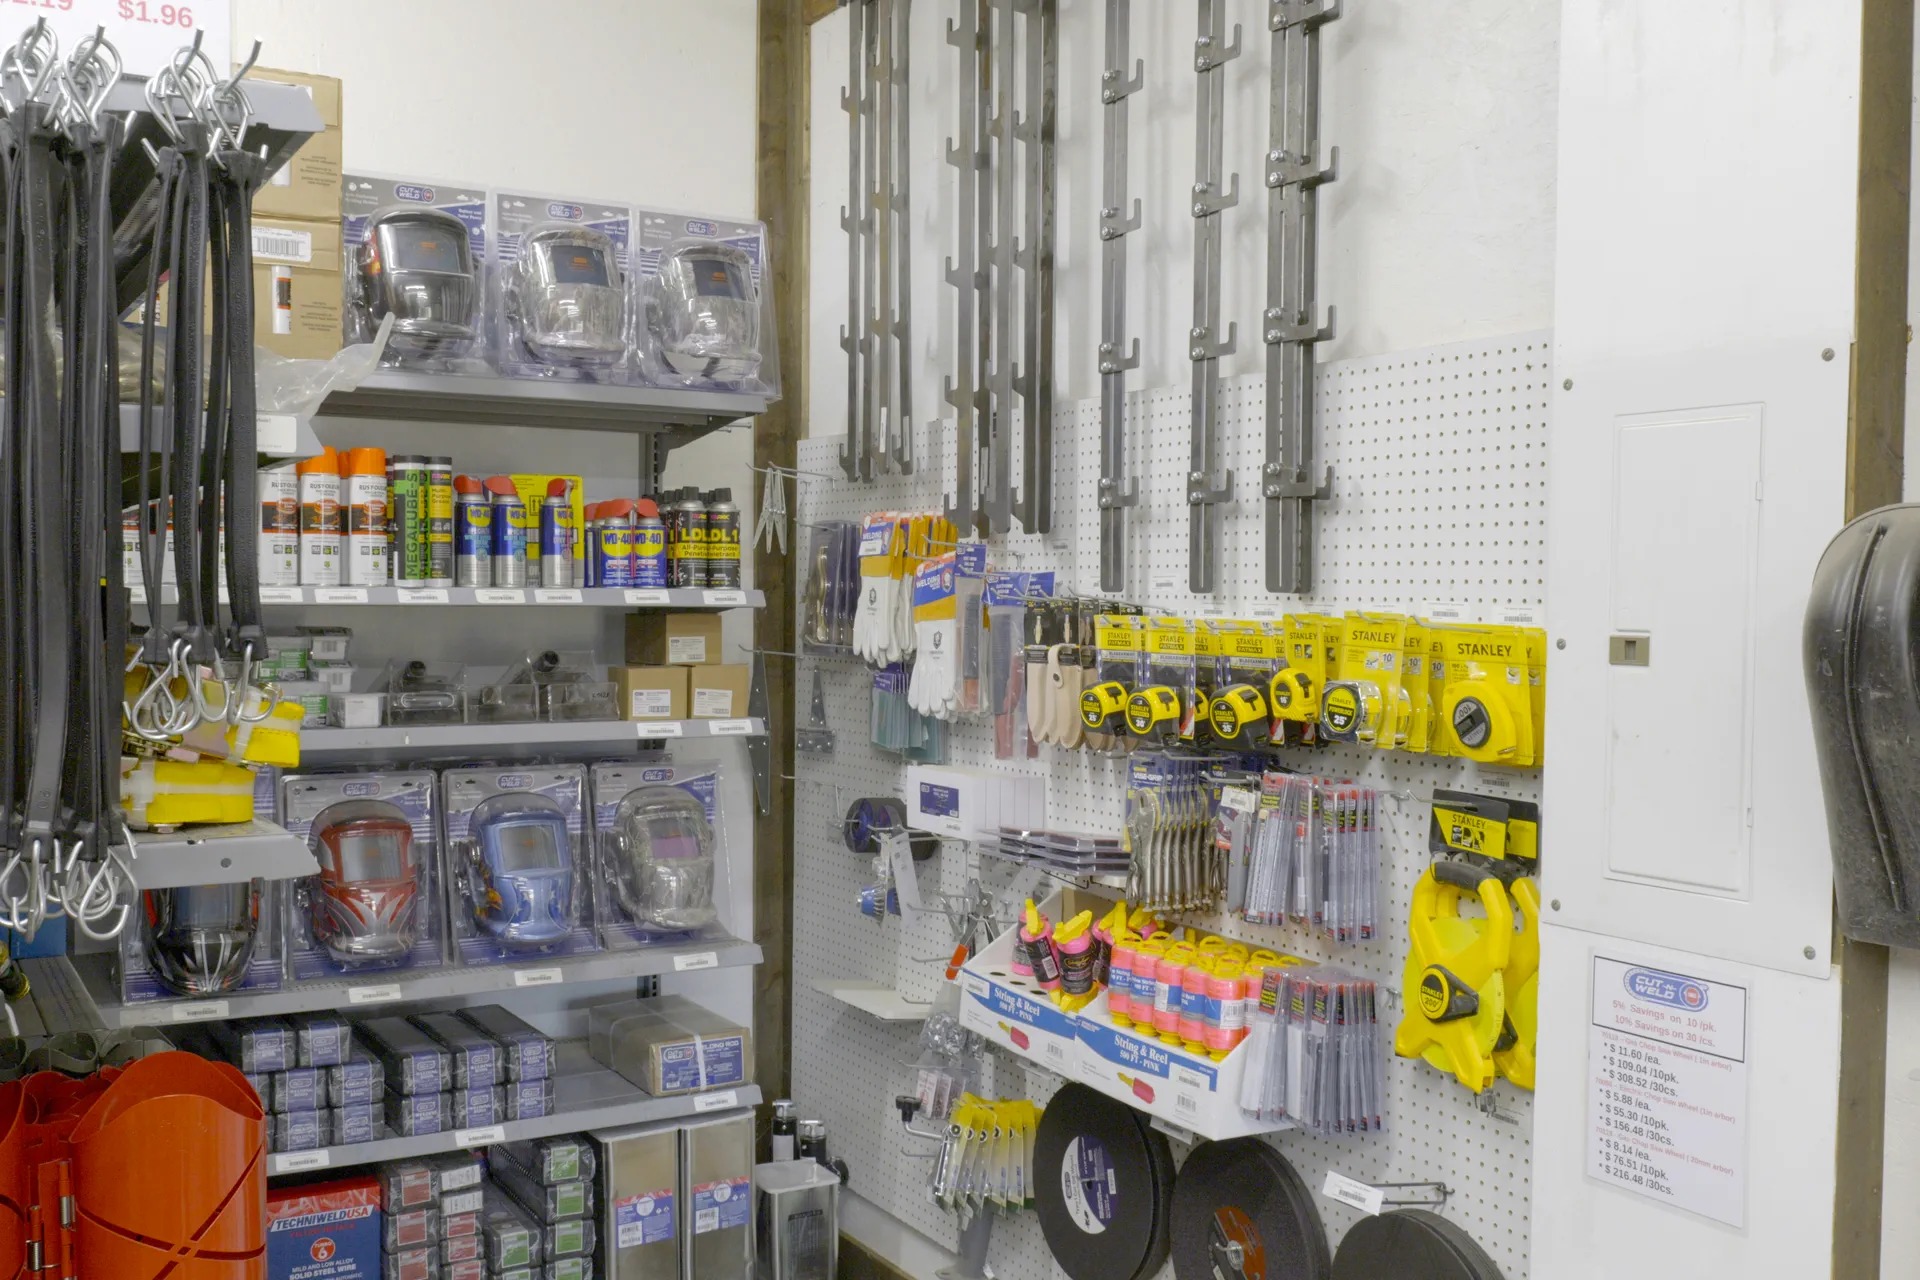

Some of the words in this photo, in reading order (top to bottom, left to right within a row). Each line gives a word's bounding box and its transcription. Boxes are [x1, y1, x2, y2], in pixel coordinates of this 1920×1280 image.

[118, 0, 193, 28] $1.96
[407, 472, 418, 577] MEGALUBE-S
[1108, 632, 1131, 640] STANLEY
[1236, 638, 1262, 646] STANLEY
[1290, 632, 1318, 640] STANLEY
[1352, 630, 1396, 643] STANLEY
[1458, 643, 1512, 656] STANLEY
[1332, 697, 1352, 706] STANLEY
[1134, 772, 1162, 780] VISE-GRIP
[1452, 814, 1486, 830] STANLEY
[1636, 976, 1664, 987] CUT
[1420, 986, 1444, 1000] STANLEY
[1635, 983, 1675, 1000] WELD
[994, 987, 1016, 1008] String
[1016, 998, 1022, 1008] &
[1024, 1000, 1040, 1017] Reel
[1008, 1006, 1016, 1015] FT
[1019, 1010, 1034, 1023] PINK
[1613, 1000, 1626, 1010] 5%
[1630, 1004, 1665, 1020] Savings
[1670, 1014, 1682, 1024] on
[1687, 1018, 1698, 1028] 10
[1615, 1015, 1634, 1027] 10%
[1634, 1020, 1670, 1036] Savings
[1672, 1030, 1684, 1040] on
[1686, 1032, 1698, 1043] 30
[1114, 1034, 1139, 1056] String
[1140, 1045, 1148, 1057] &
[1149, 1048, 1168, 1066] Reel
[1618, 1046, 1642, 1060] 11.60
[1644, 1052, 1661, 1065] /ea.
[1639, 1041, 1656, 1052] Chop
[1672, 1050, 1693, 1060] Wheel
[1120, 1050, 1130, 1061] 500
[1130, 1053, 1140, 1064] FT
[1143, 1059, 1160, 1073] PINK
[1617, 1060, 1648, 1075] 109.04
[1650, 1068, 1680, 1084] /10pk.
[1617, 1072, 1648, 1088] 308.52
[1650, 1082, 1678, 1098] /30cs.
[1614, 1092, 1633, 1106] 5.88
[1634, 1098, 1652, 1112] /ea.
[1644, 1092, 1662, 1103] Chop
[1662, 1097, 1676, 1106] Saw
[1678, 1102, 1698, 1112] Wheel
[1714, 1110, 1736, 1124] arbor)
[1613, 1106, 1638, 1121] 55.30
[1640, 1114, 1670, 1132] /10pk.
[1614, 1120, 1644, 1137] 156.48
[1646, 1129, 1675, 1146] /30cs.
[1614, 1142, 1632, 1156] 8.14
[1634, 1148, 1652, 1162] /ea.
[1632, 1137, 1649, 1149] Chop
[1650, 1144, 1663, 1153] Saw
[1664, 1148, 1685, 1160] Wheel
[1712, 1164, 1734, 1176] arbor)
[1614, 1154, 1638, 1170] 76.51
[1640, 1162, 1668, 1180] /10pk.
[1613, 1168, 1644, 1185] 216.48
[1646, 1178, 1674, 1196] /30cs.
[318, 1247, 328, 1260] 6
[289, 1272, 312, 1280] SOLID
[314, 1267, 337, 1277] STEEL
[337, 1264, 356, 1273] WIRE
[292, 1265, 307, 1274] MILD
[308, 1263, 321, 1271] AND
[322, 1260, 335, 1268] LOW
[335, 1258, 354, 1266] ALLOY
